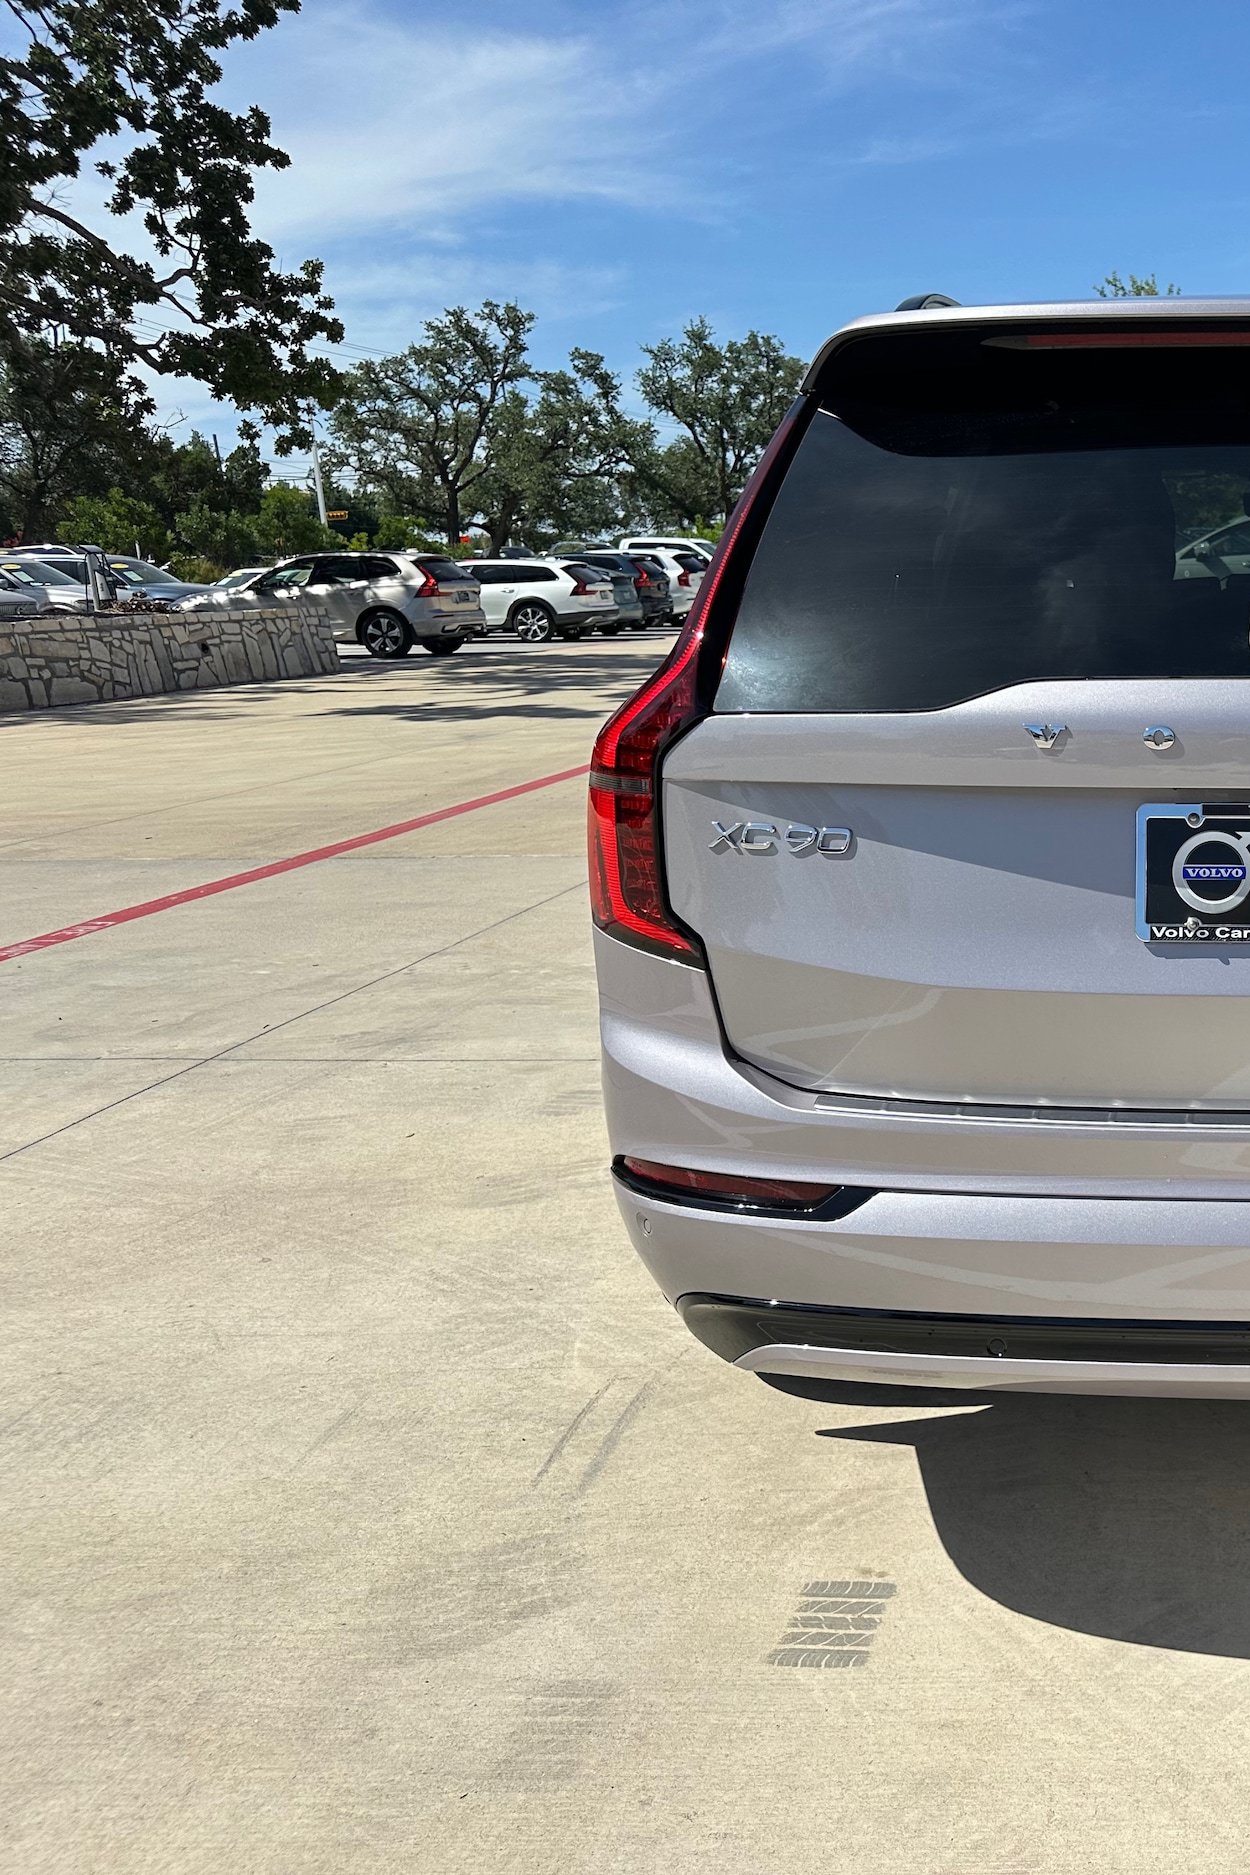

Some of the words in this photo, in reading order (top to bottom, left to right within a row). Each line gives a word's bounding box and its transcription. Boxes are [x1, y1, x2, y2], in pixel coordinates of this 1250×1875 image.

[708, 821, 853, 854] XC90
[1185, 867, 1243, 878] VOLVO
[1152, 926, 1209, 939] Volvo
